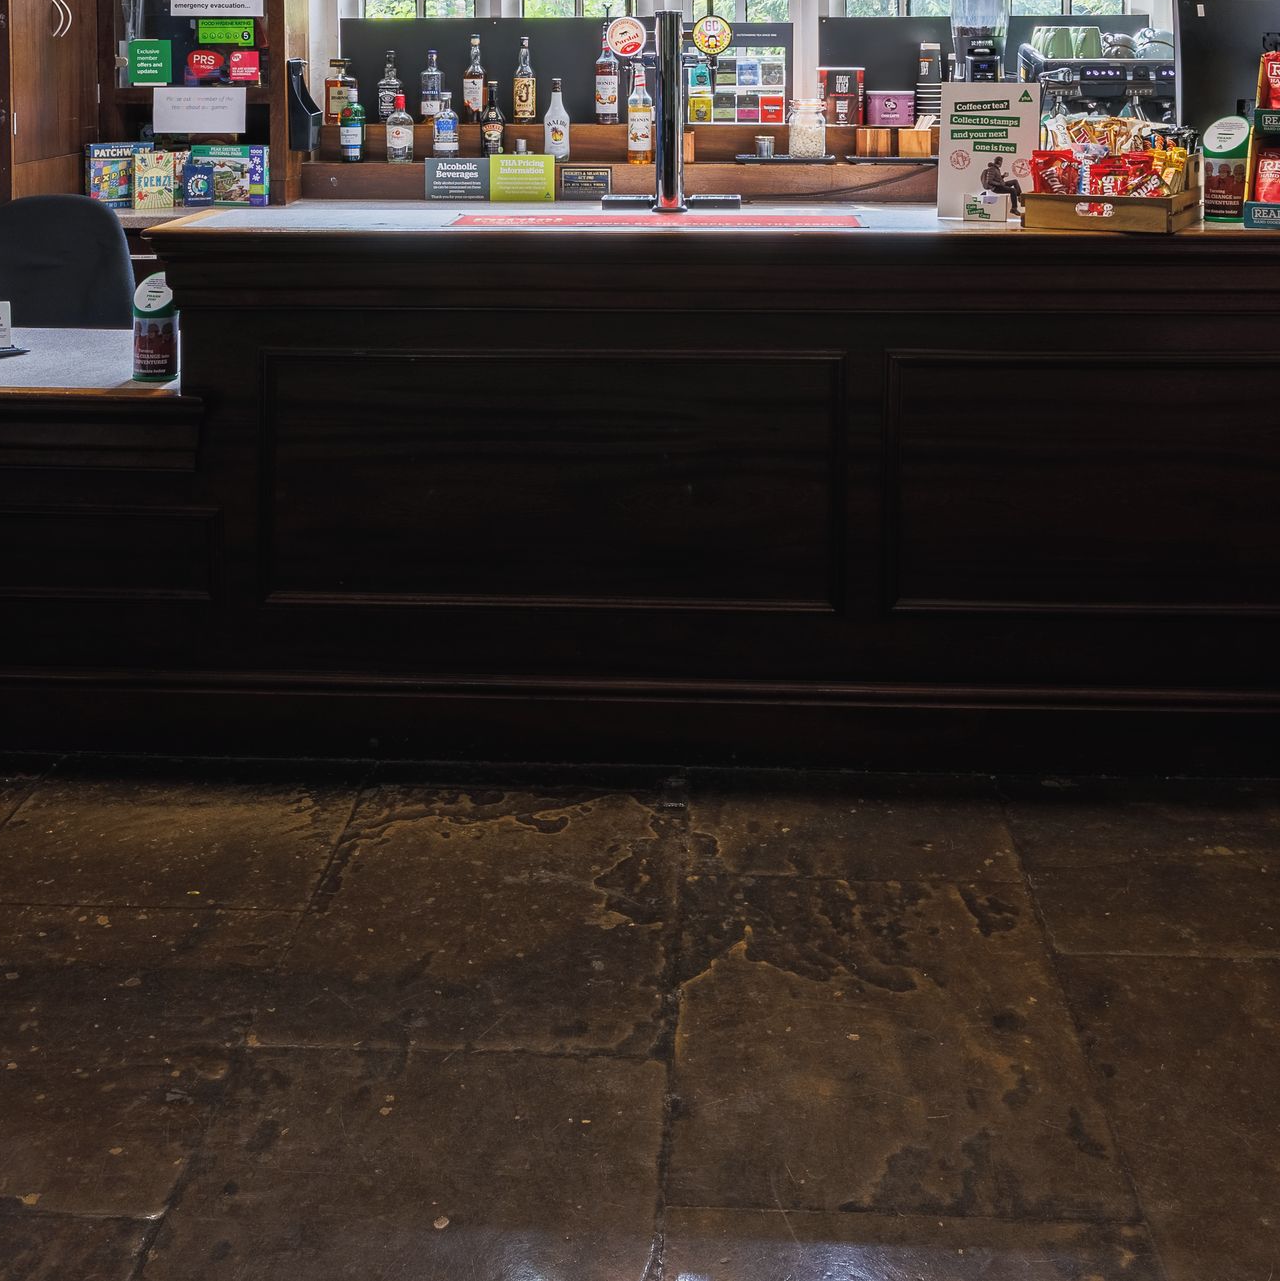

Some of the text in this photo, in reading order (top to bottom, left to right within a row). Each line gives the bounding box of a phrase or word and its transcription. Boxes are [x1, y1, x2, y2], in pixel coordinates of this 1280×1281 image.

[243, 32, 249, 40] 5
[614, 32, 640, 48] Pardal
[193, 54, 216, 65] PRS
[956, 103, 982, 111] Coffee
[991, 101, 1008, 109] tea?
[952, 116, 1019, 127] Collect 10 stamps
[952, 130, 1007, 140] and your next
[991, 144, 998, 152] is
[998, 144, 1016, 153] free
[437, 162, 477, 171] Alcoholic
[499, 159, 545, 168] YHA Pricing
[436, 170, 479, 180] Beverages
[499, 167, 545, 175] Information
